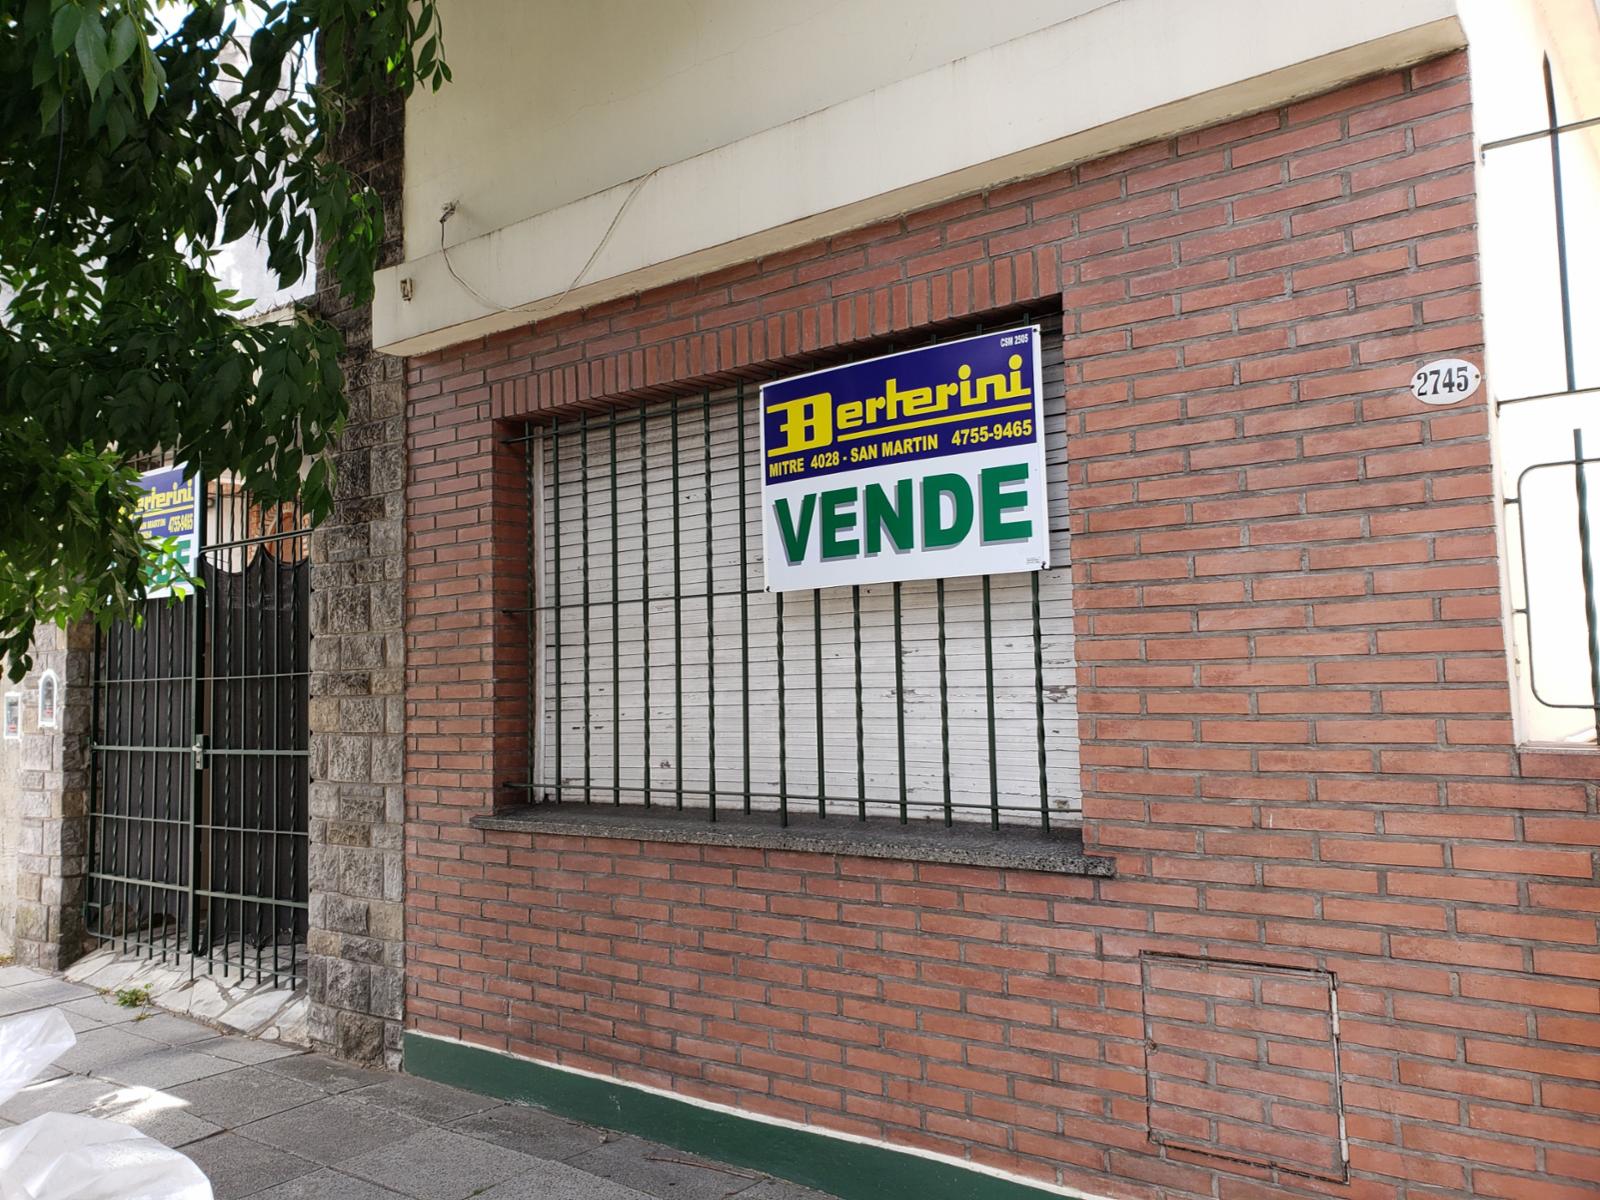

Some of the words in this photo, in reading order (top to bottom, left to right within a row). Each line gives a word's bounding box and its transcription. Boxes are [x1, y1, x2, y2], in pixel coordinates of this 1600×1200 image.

[767, 354, 1031, 457] Berterini
[1416, 366, 1469, 396] 2745
[769, 458, 804, 478] MITRE
[810, 451, 840, 469] 4028
[850, 445, 878, 463] SAN
[882, 434, 938, 458] MARTIN
[951, 419, 1032, 446] 4755-9465
[136, 479, 194, 513] erterini
[773, 462, 1033, 566] VENDE
